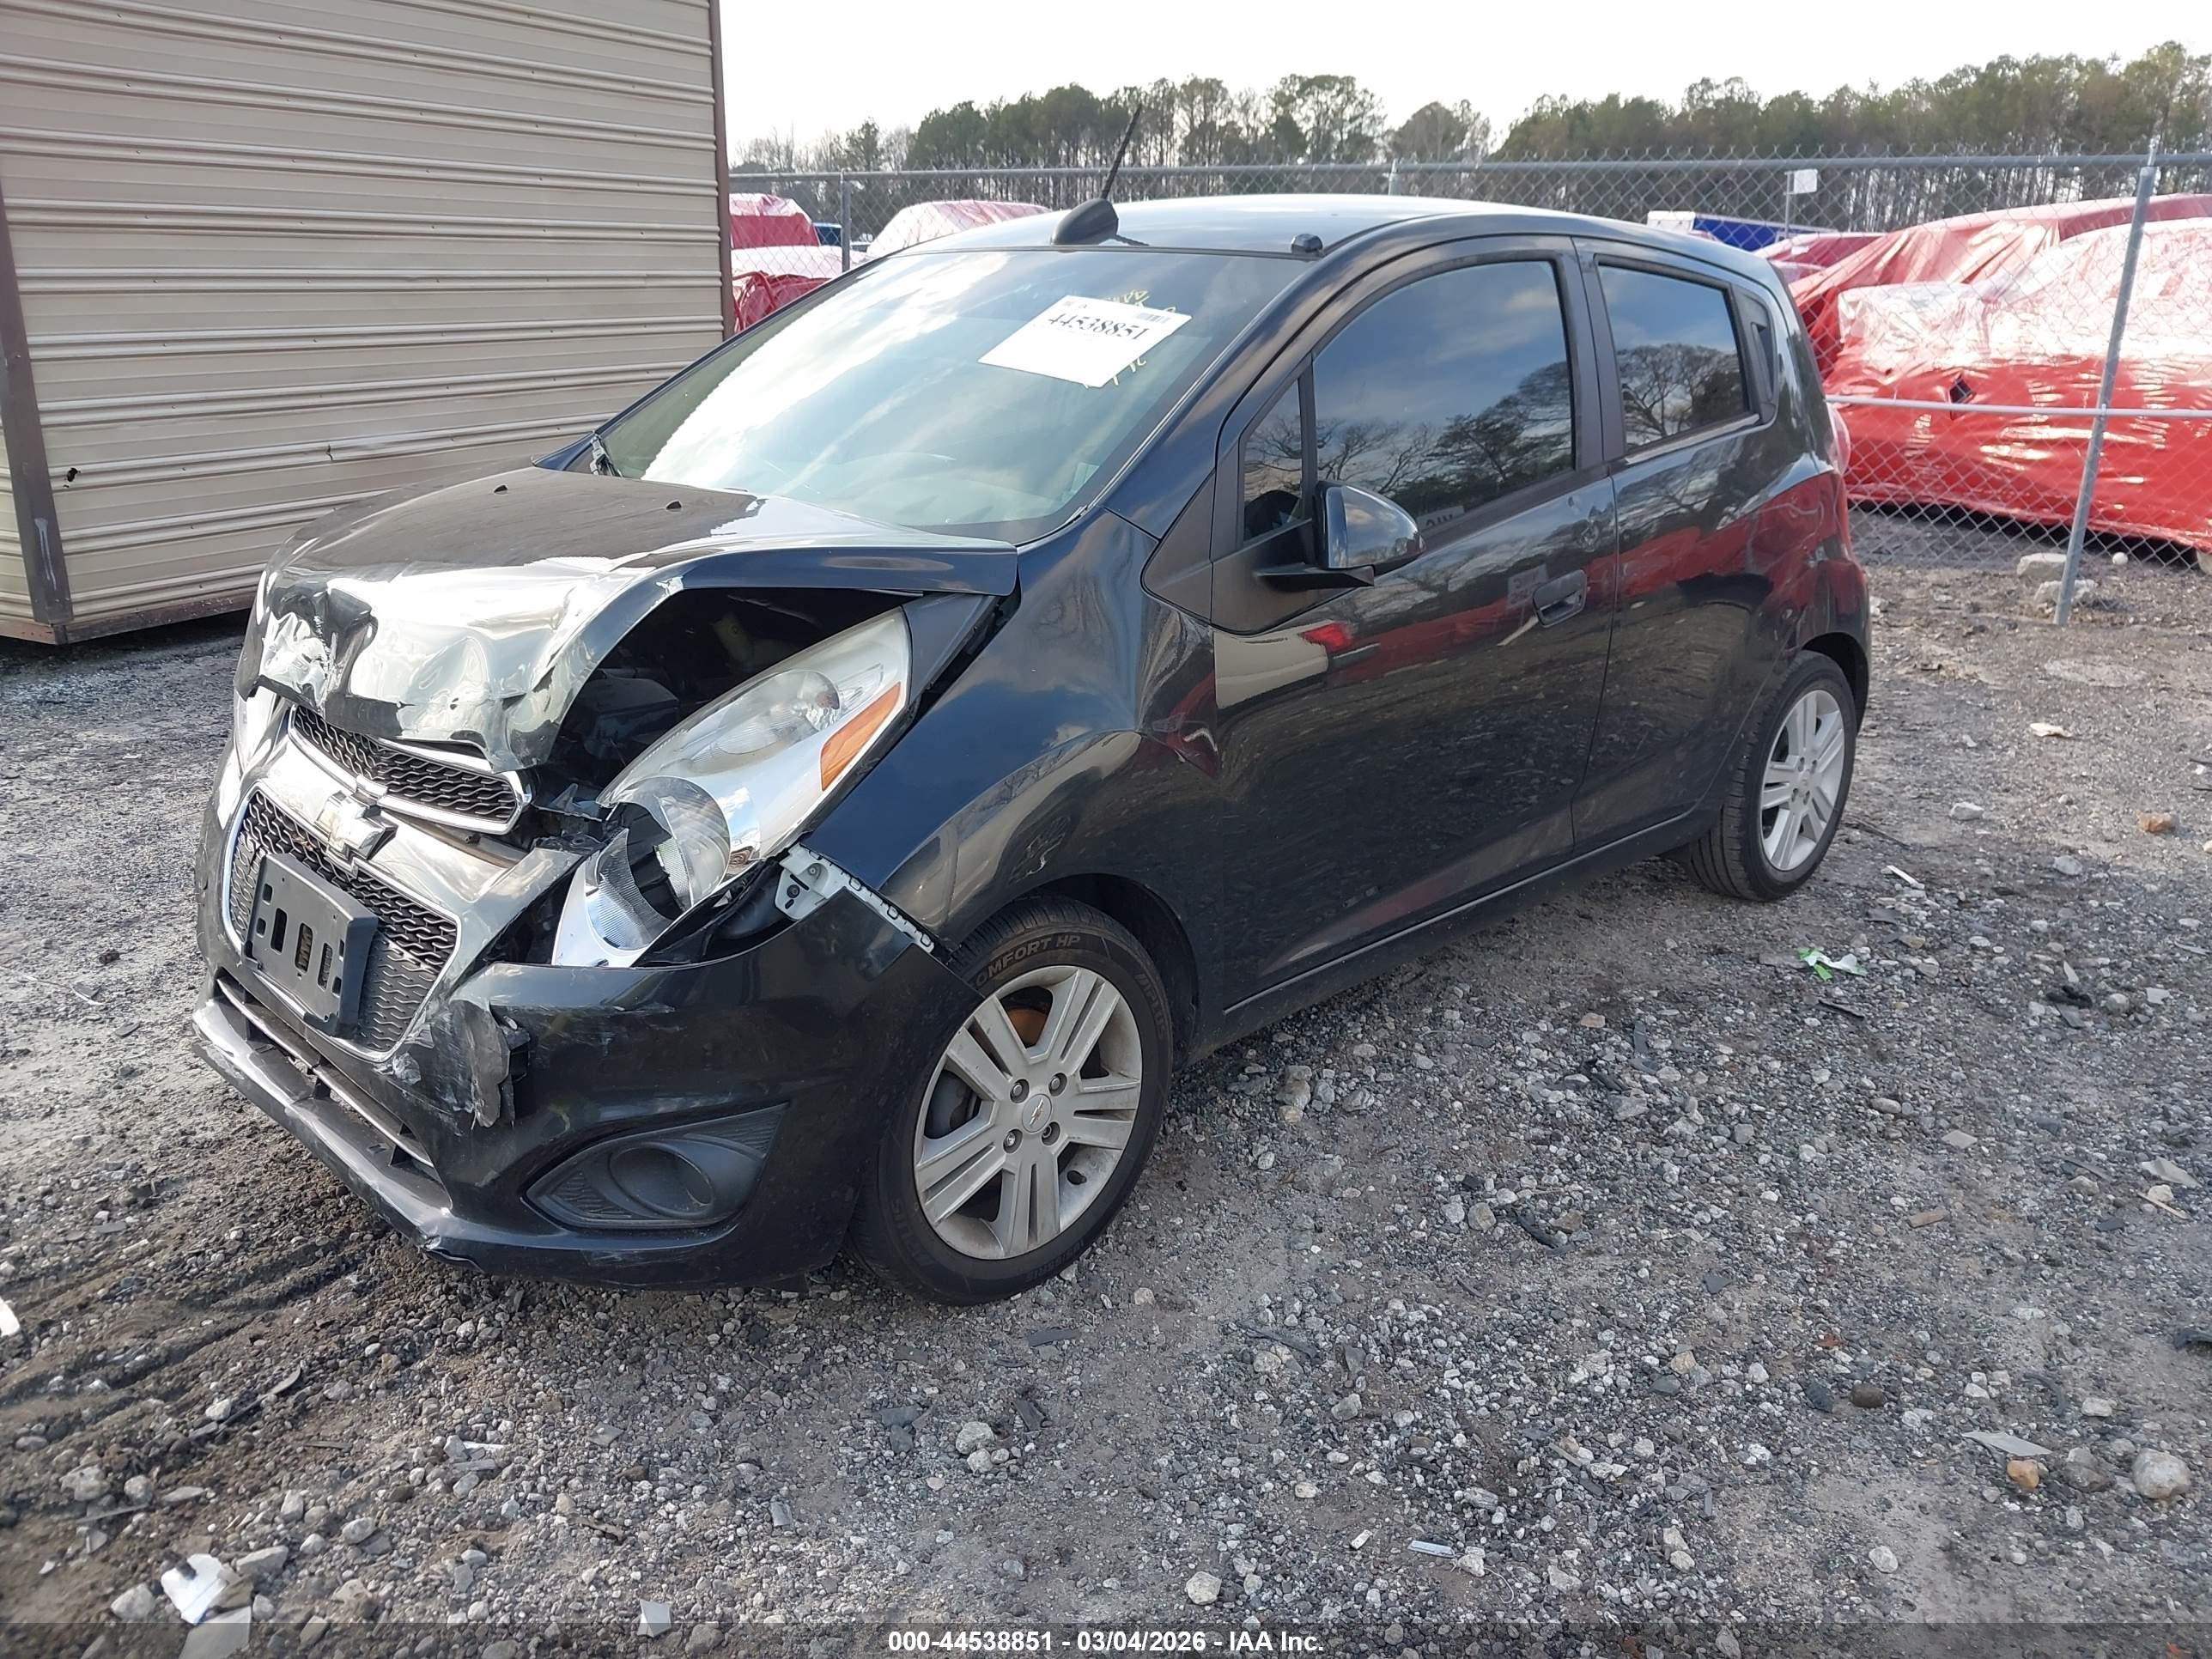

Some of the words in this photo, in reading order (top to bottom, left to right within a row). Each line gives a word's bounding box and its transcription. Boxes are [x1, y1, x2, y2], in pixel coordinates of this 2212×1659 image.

[1047, 312, 1149, 340] 44538851
[975, 937, 1053, 990] OMFORT
[1055, 934, 1082, 948] HP
